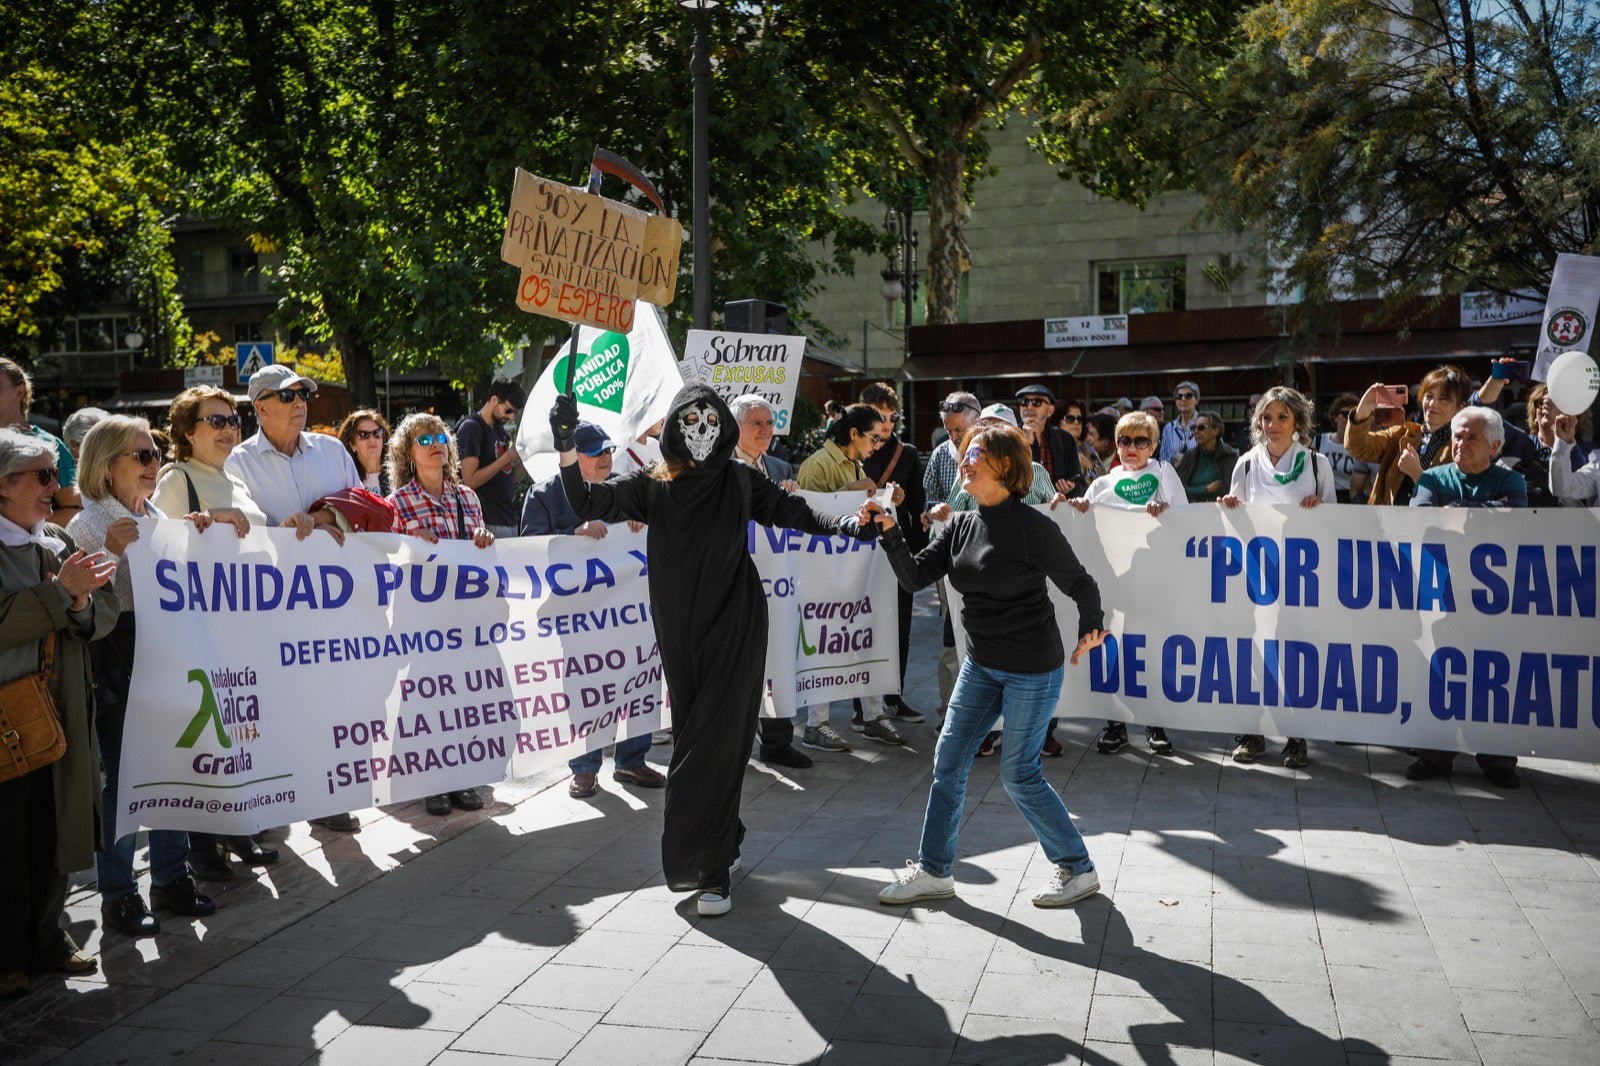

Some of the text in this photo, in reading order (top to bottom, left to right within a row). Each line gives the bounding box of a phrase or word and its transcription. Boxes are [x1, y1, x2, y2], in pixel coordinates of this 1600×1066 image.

[535, 181, 630, 245] SOY LA
[520, 275, 634, 331] OS ESPERO
[1081, 321, 1091, 329] 12
[573, 344, 620, 384] ANIDAD
[701, 336, 790, 365] Sobran
[575, 358, 625, 397] PÚBLICA
[593, 378, 624, 404] 100%
[712, 365, 786, 384] EXCUSAS
[1325, 452, 1355, 475] YC
[1121, 480, 1152, 492] SANIDAD
[155, 559, 354, 612] SANIDAD
[374, 554, 616, 606] PÚBLICA
[1337, 538, 1457, 613] UNA
[1469, 543, 1597, 618] SAN
[803, 596, 873, 624] europa
[280, 627, 463, 667] DEFENDAMOS
[474, 620, 527, 647] LOS
[537, 602, 653, 638] SERVICI
[818, 624, 873, 655] laica
[210, 666, 257, 688] Andalucía
[400, 674, 457, 702] POR
[464, 667, 505, 692] UN
[514, 649, 626, 685] ESTADO
[1089, 632, 1600, 730] DE CALIDAD, GRAT
[333, 663, 663, 749] POR LA LIBERTAD DE CON
[326, 734, 506, 795] ¡SEPARACIÓN
